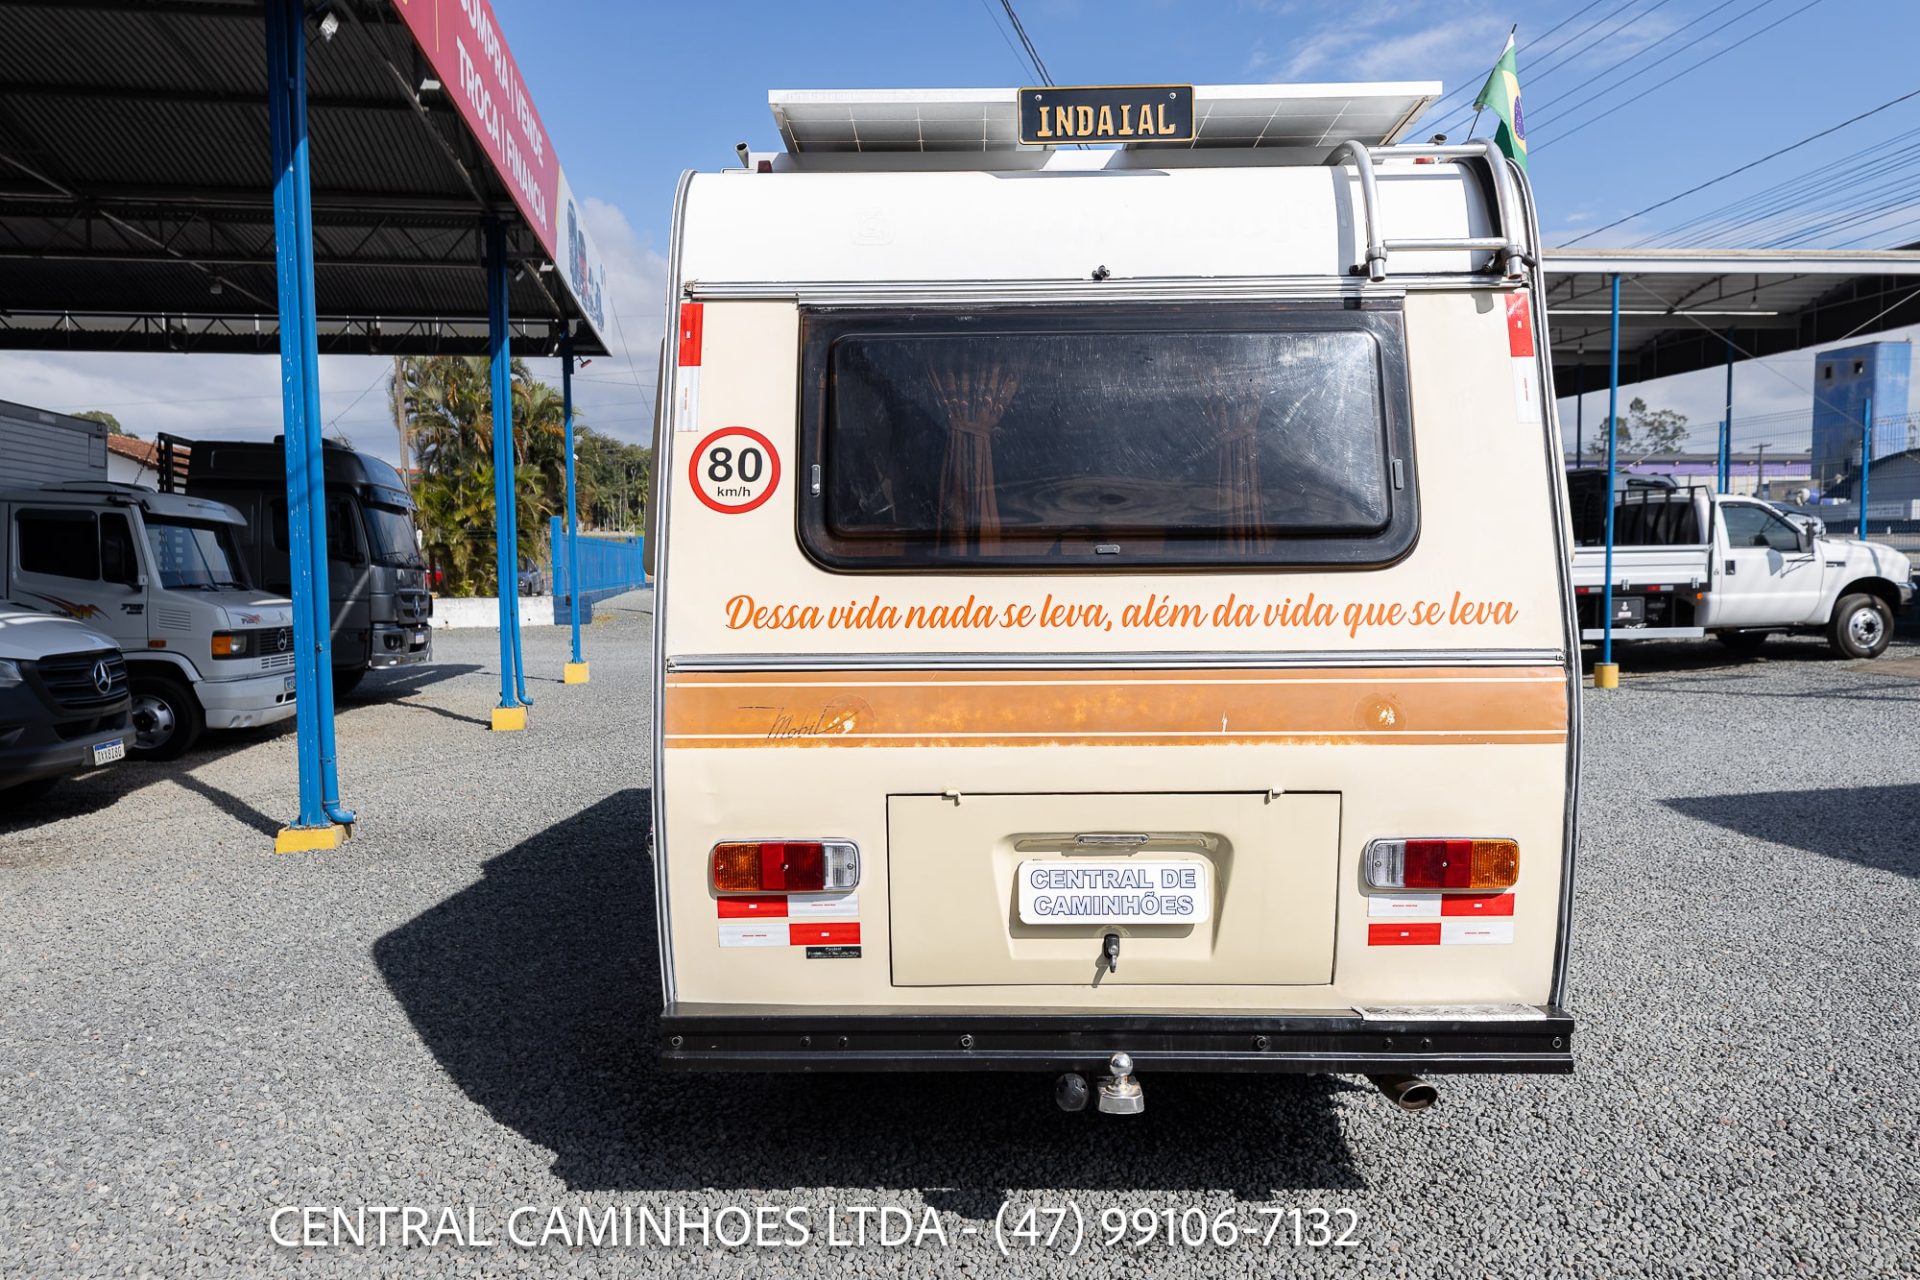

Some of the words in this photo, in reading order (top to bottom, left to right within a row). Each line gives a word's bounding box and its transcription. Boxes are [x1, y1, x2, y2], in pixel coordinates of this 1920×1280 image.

[457, 35, 501, 150] TROCA
[506, 128, 548, 231] FINANCIA
[515, 79, 544, 168] VENDE
[1037, 103, 1177, 137] INDAIAL
[707, 446, 763, 483] 80
[717, 486, 751, 497] km/h
[725, 594, 824, 631] Dessa
[827, 595, 903, 630] vida
[904, 593, 998, 630] nada
[999, 603, 1037, 629] se
[1040, 592, 1113, 633] leva,
[1121, 592, 1209, 629] além
[1212, 592, 1260, 628] da
[1264, 591, 1340, 628] vida
[1343, 602, 1406, 640] que
[1408, 600, 1445, 627] se
[1449, 590, 1519, 626] leva
[1030, 869, 1154, 889] CENTRAL
[1161, 868, 1197, 889] DE
[1033, 891, 1194, 916] CAMINHÕES
